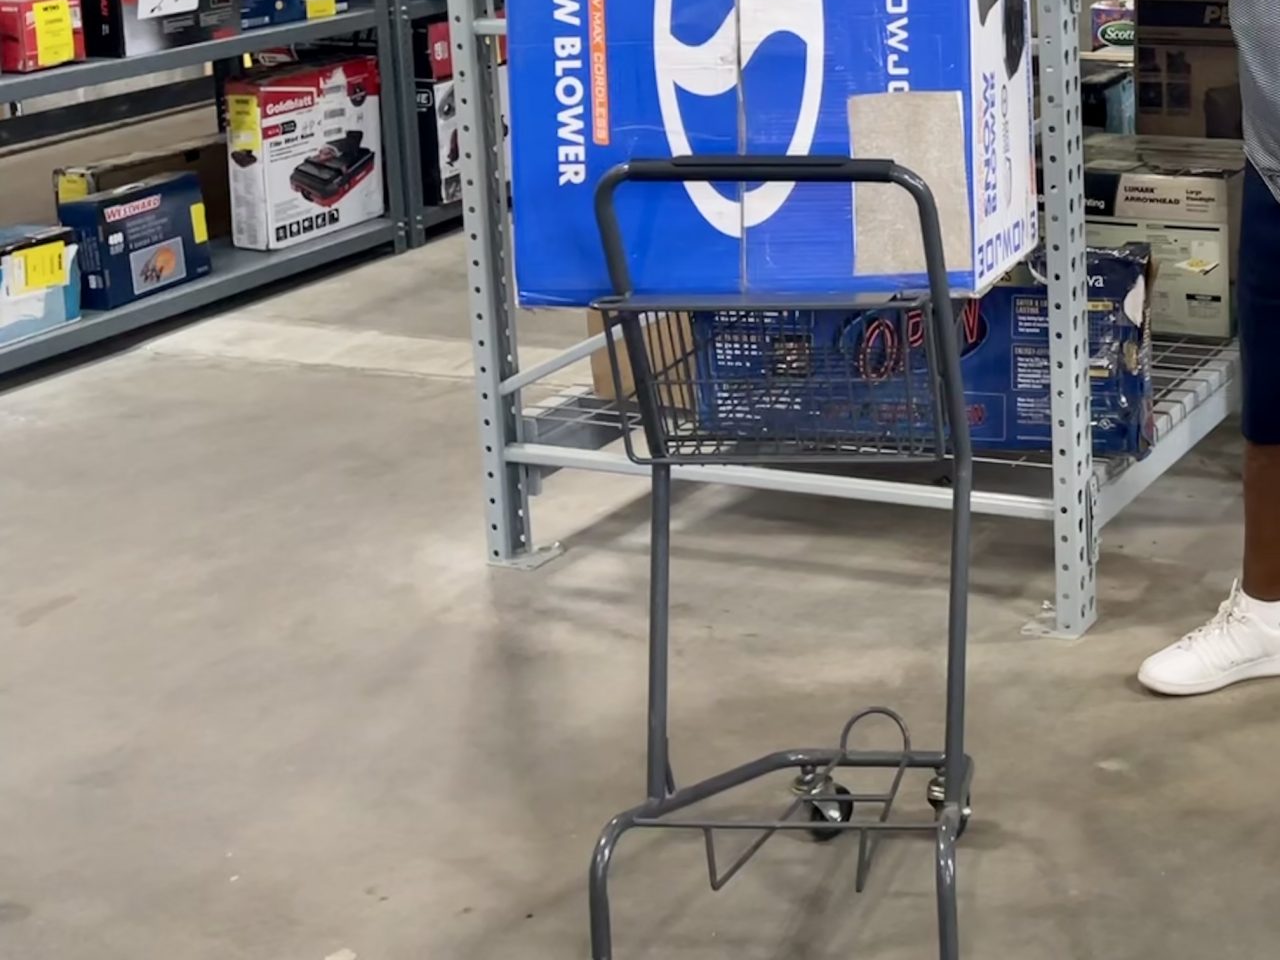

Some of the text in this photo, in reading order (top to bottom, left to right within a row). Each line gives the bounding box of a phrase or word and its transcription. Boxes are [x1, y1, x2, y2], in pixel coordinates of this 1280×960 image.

[593, 12, 603, 45] MAX
[265, 95, 313, 116] Goldblatt
[593, 51, 607, 140] CORDLESS
[555, 36, 586, 186] BLOWER
[104, 194, 162, 222] WESTWARD
[1124, 196, 1180, 205] ARROWHEAD
